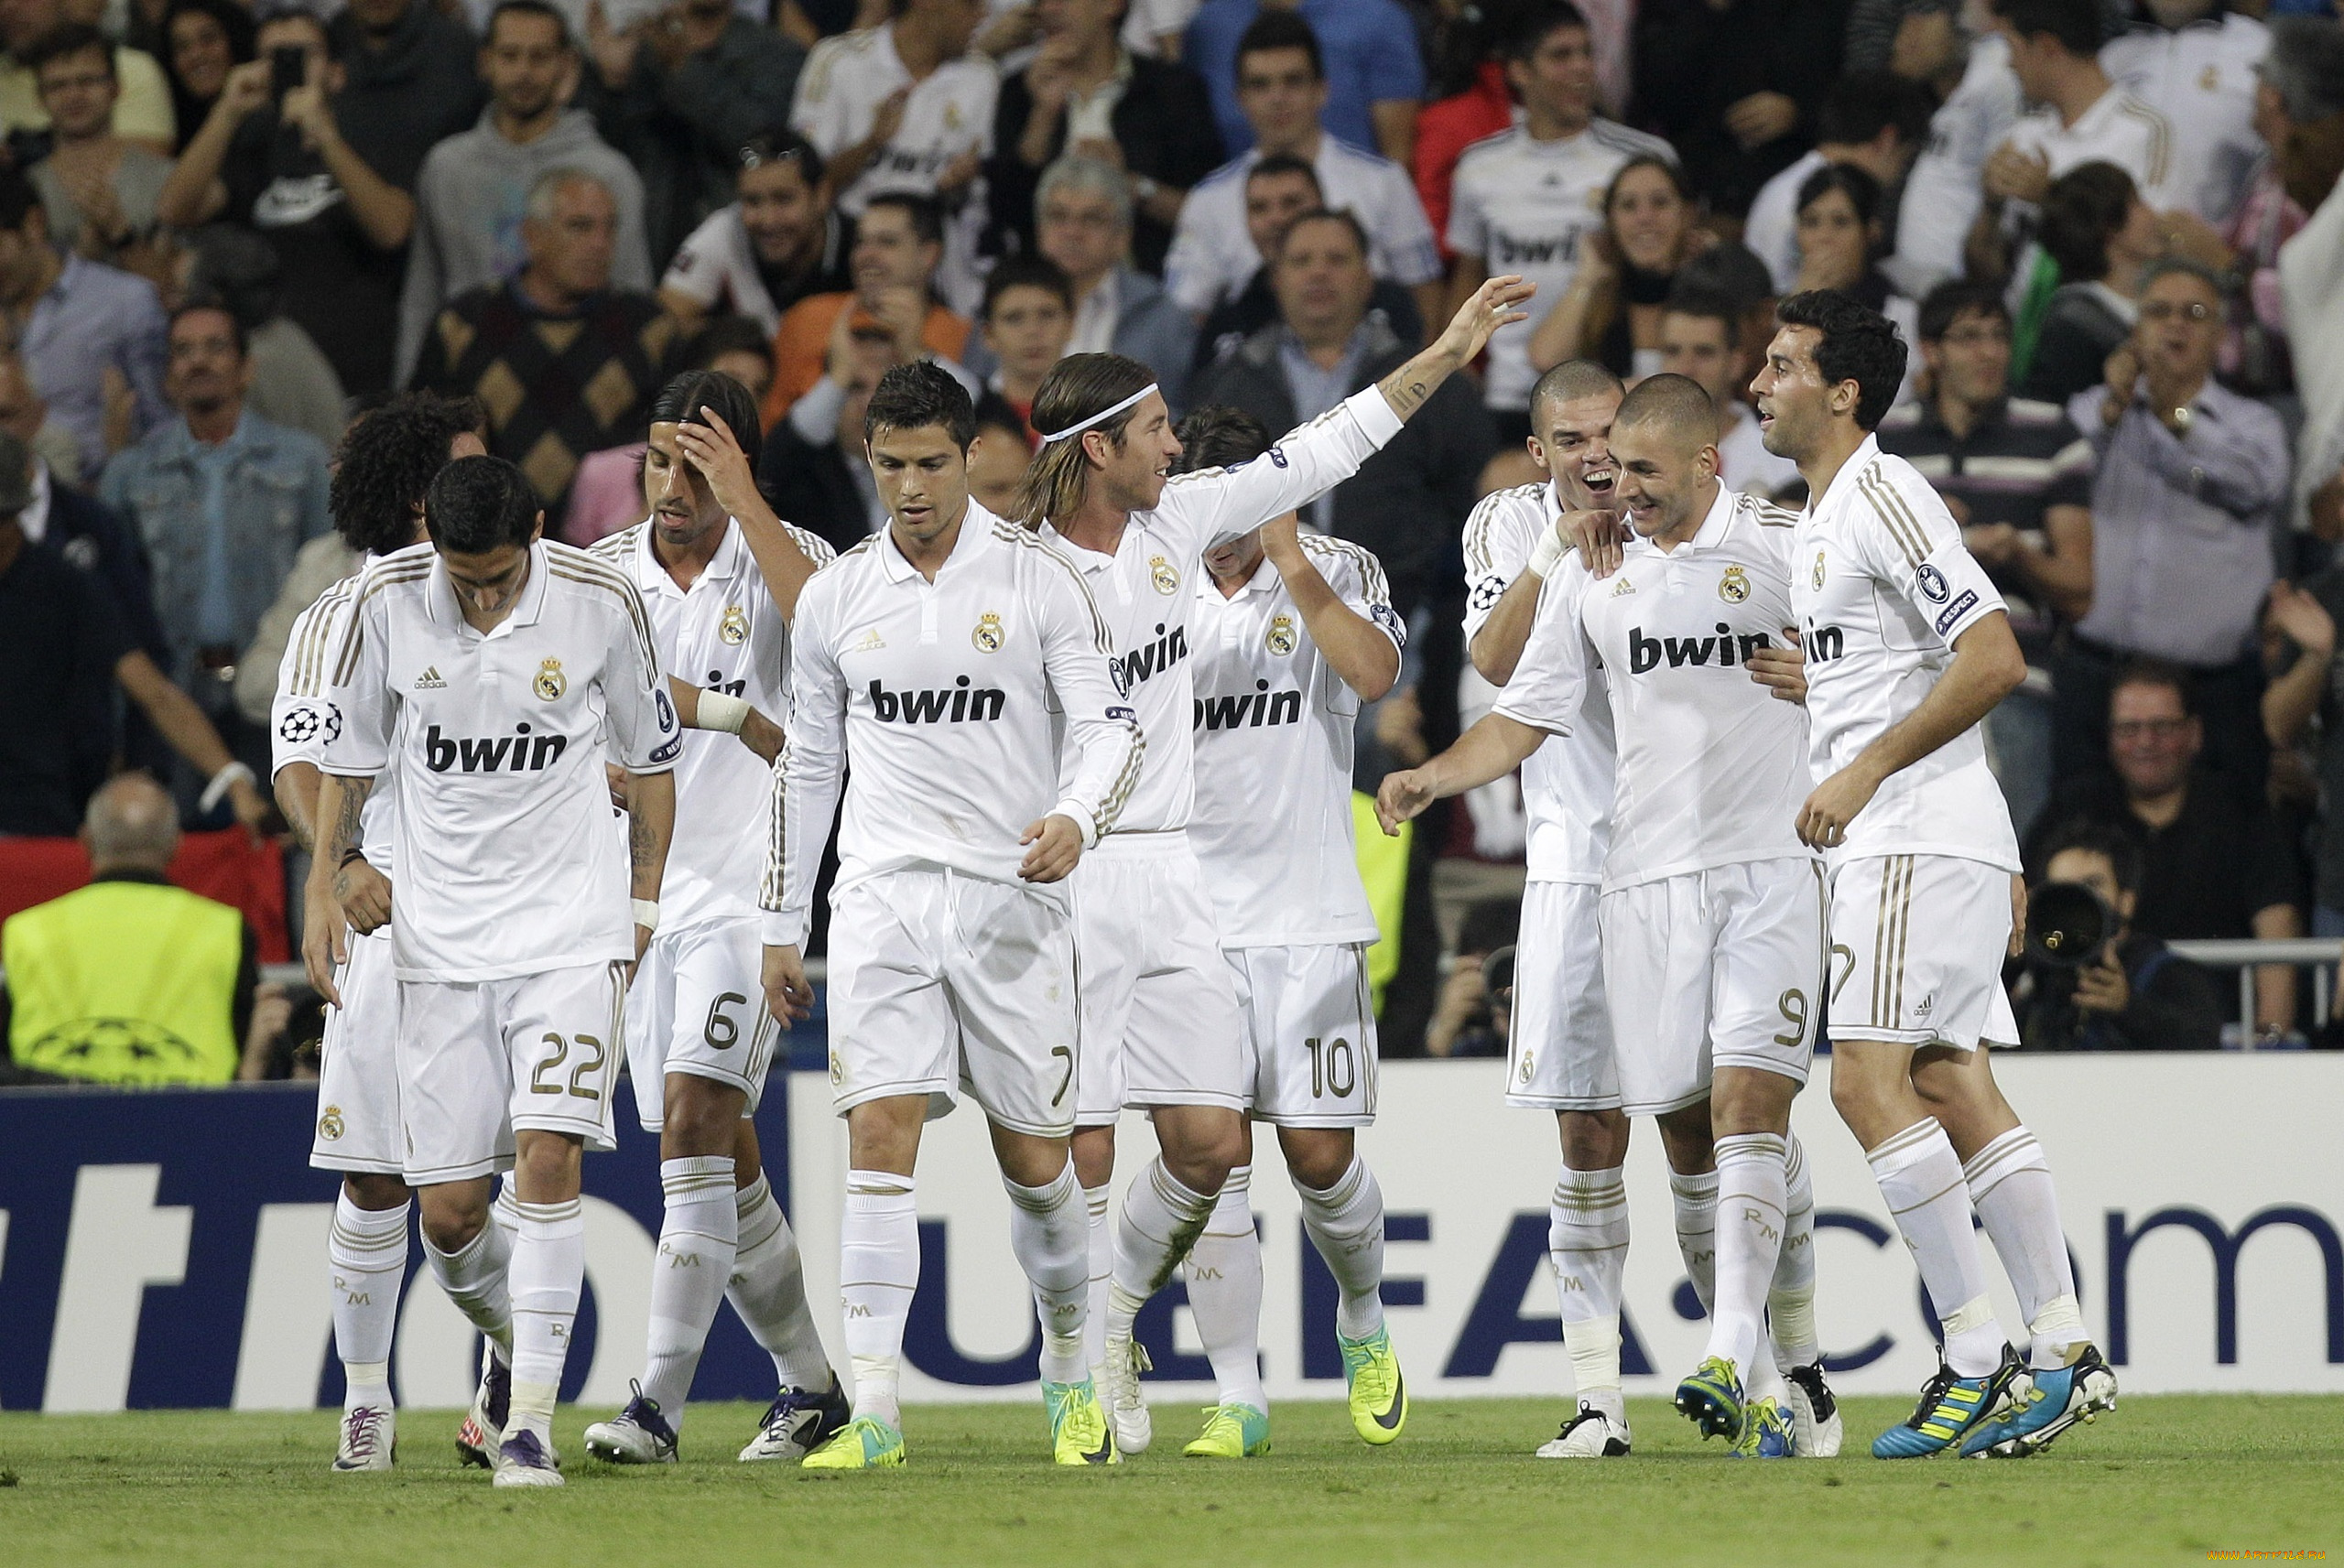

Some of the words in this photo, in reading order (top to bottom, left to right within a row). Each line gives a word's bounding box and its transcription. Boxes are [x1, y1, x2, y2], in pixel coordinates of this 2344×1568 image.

[1496, 223, 1581, 264] bwi
[1942, 591, 1975, 624] RESPECT
[1119, 622, 1188, 688] win
[1629, 622, 1771, 675] bwin
[414, 681, 448, 689] adidas
[869, 675, 1005, 724] bwin
[426, 722, 568, 773] bwin
[704, 991, 747, 1050] 6
[1774, 988, 1808, 1047] 9
[530, 1032, 605, 1100] 22
[1051, 1045, 1073, 1108] 7
[1304, 1037, 1355, 1098] 10
[1744, 1207, 1779, 1246] RM
[334, 1275, 371, 1306] RM
